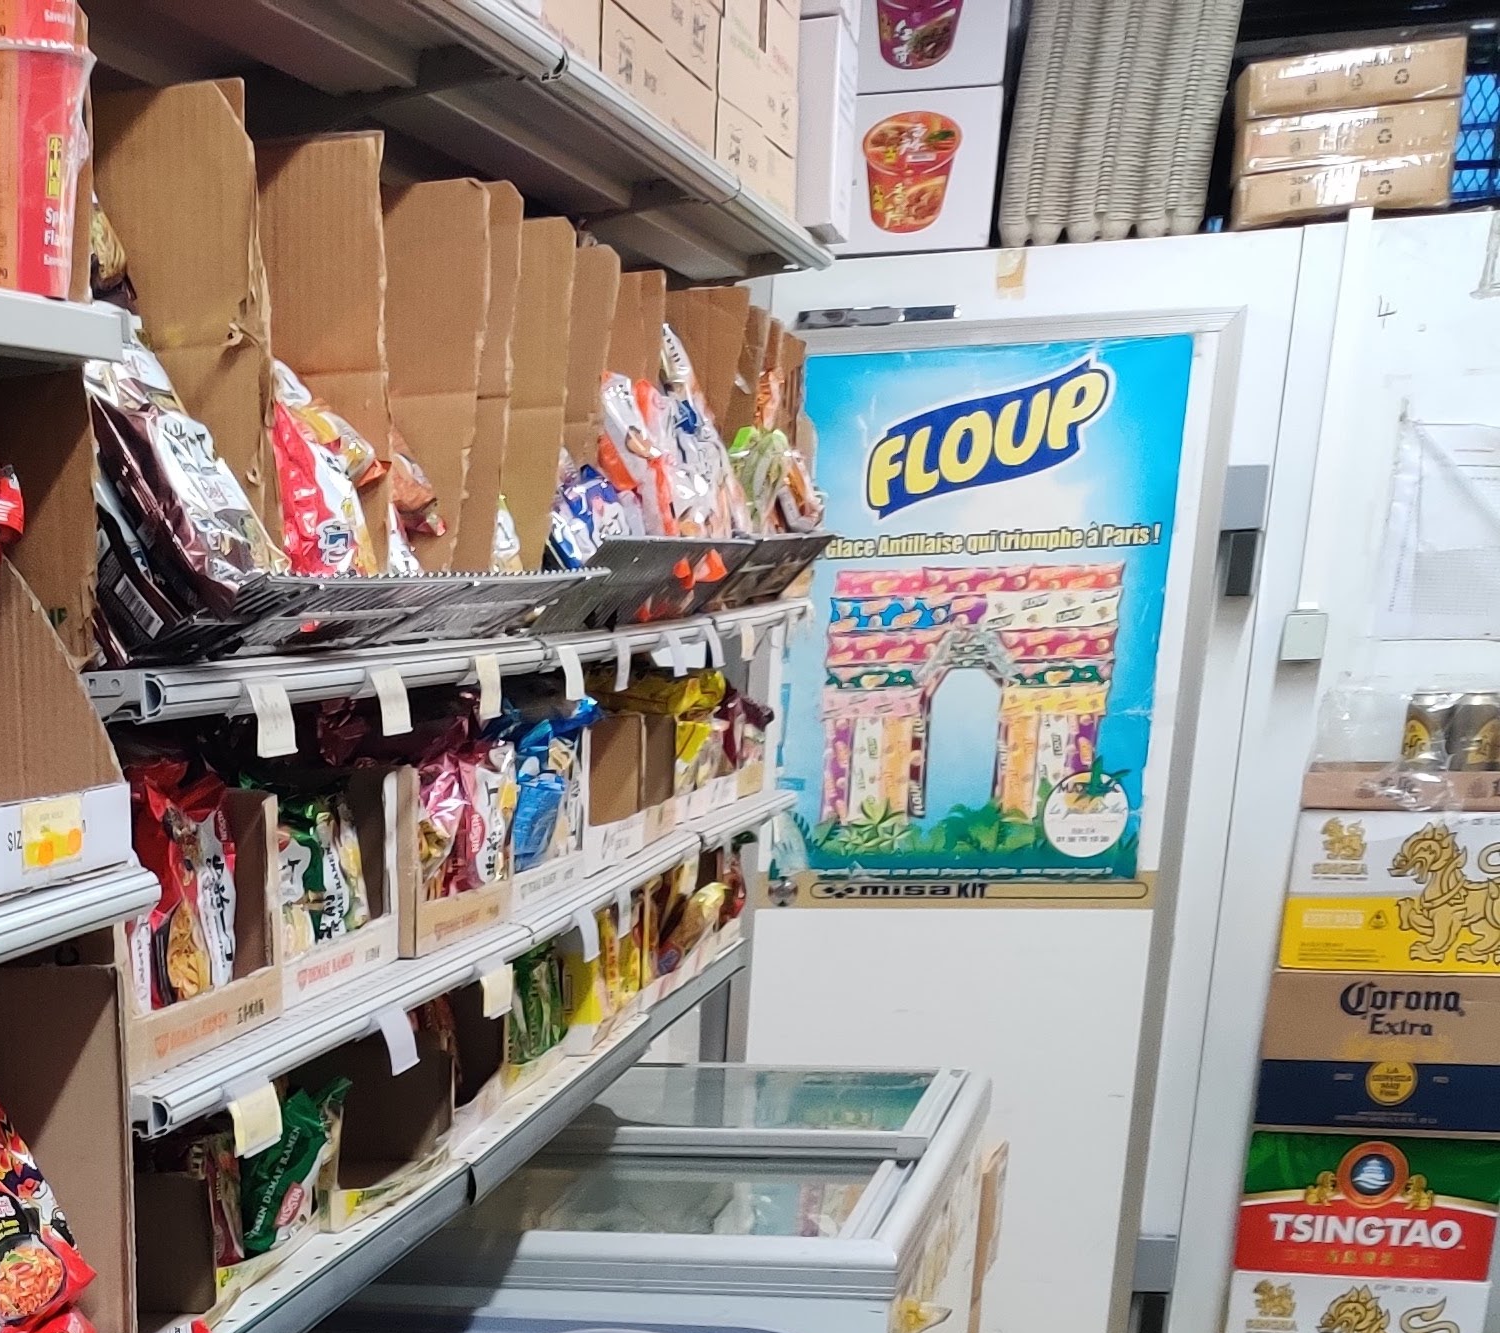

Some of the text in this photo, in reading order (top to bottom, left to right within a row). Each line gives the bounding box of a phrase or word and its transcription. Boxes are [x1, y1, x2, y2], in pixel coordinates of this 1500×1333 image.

[867, 368, 1110, 511] FLOUP
[877, 532, 963, 558] Antillaise
[966, 531, 996, 555] qui
[999, 527, 1084, 553] triomphe
[1087, 522, 1099, 546] à
[1102, 525, 1150, 546] Paris
[859, 882, 987, 899] misa KIT
[1339, 981, 1464, 1017] Corona
[1369, 1014, 1434, 1037] Extra
[281, 1125, 301, 1166] RAMEN
[1268, 1212, 1464, 1250] TSINGTAO
